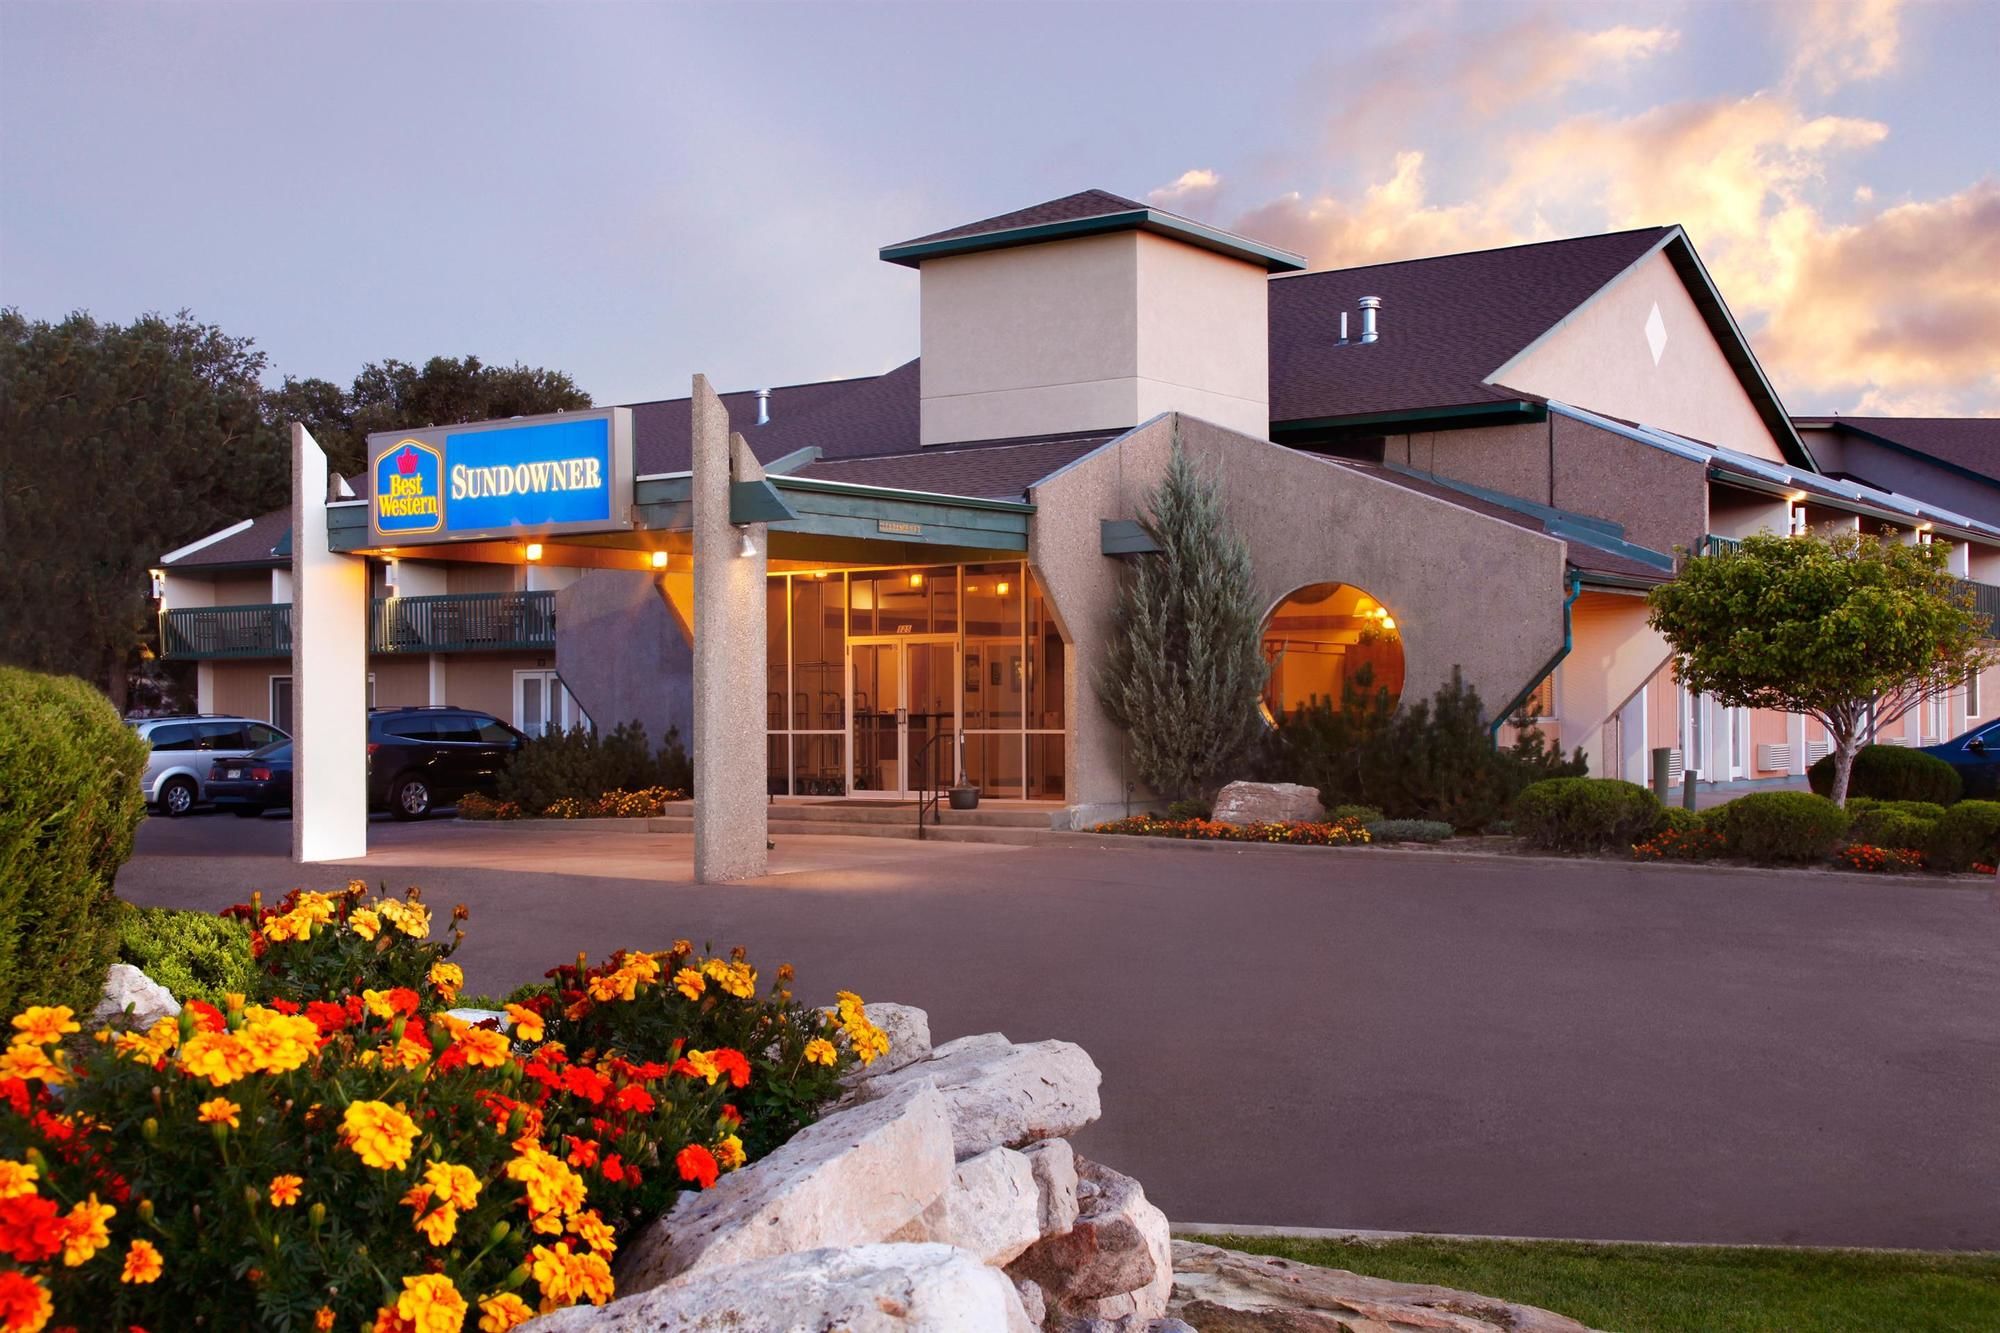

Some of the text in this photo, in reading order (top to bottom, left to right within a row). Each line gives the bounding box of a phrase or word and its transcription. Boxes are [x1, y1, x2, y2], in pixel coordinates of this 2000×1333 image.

[390, 473, 422, 496] Best
[452, 457, 601, 500] SUNDOWNER
[378, 495, 437, 516] Western
